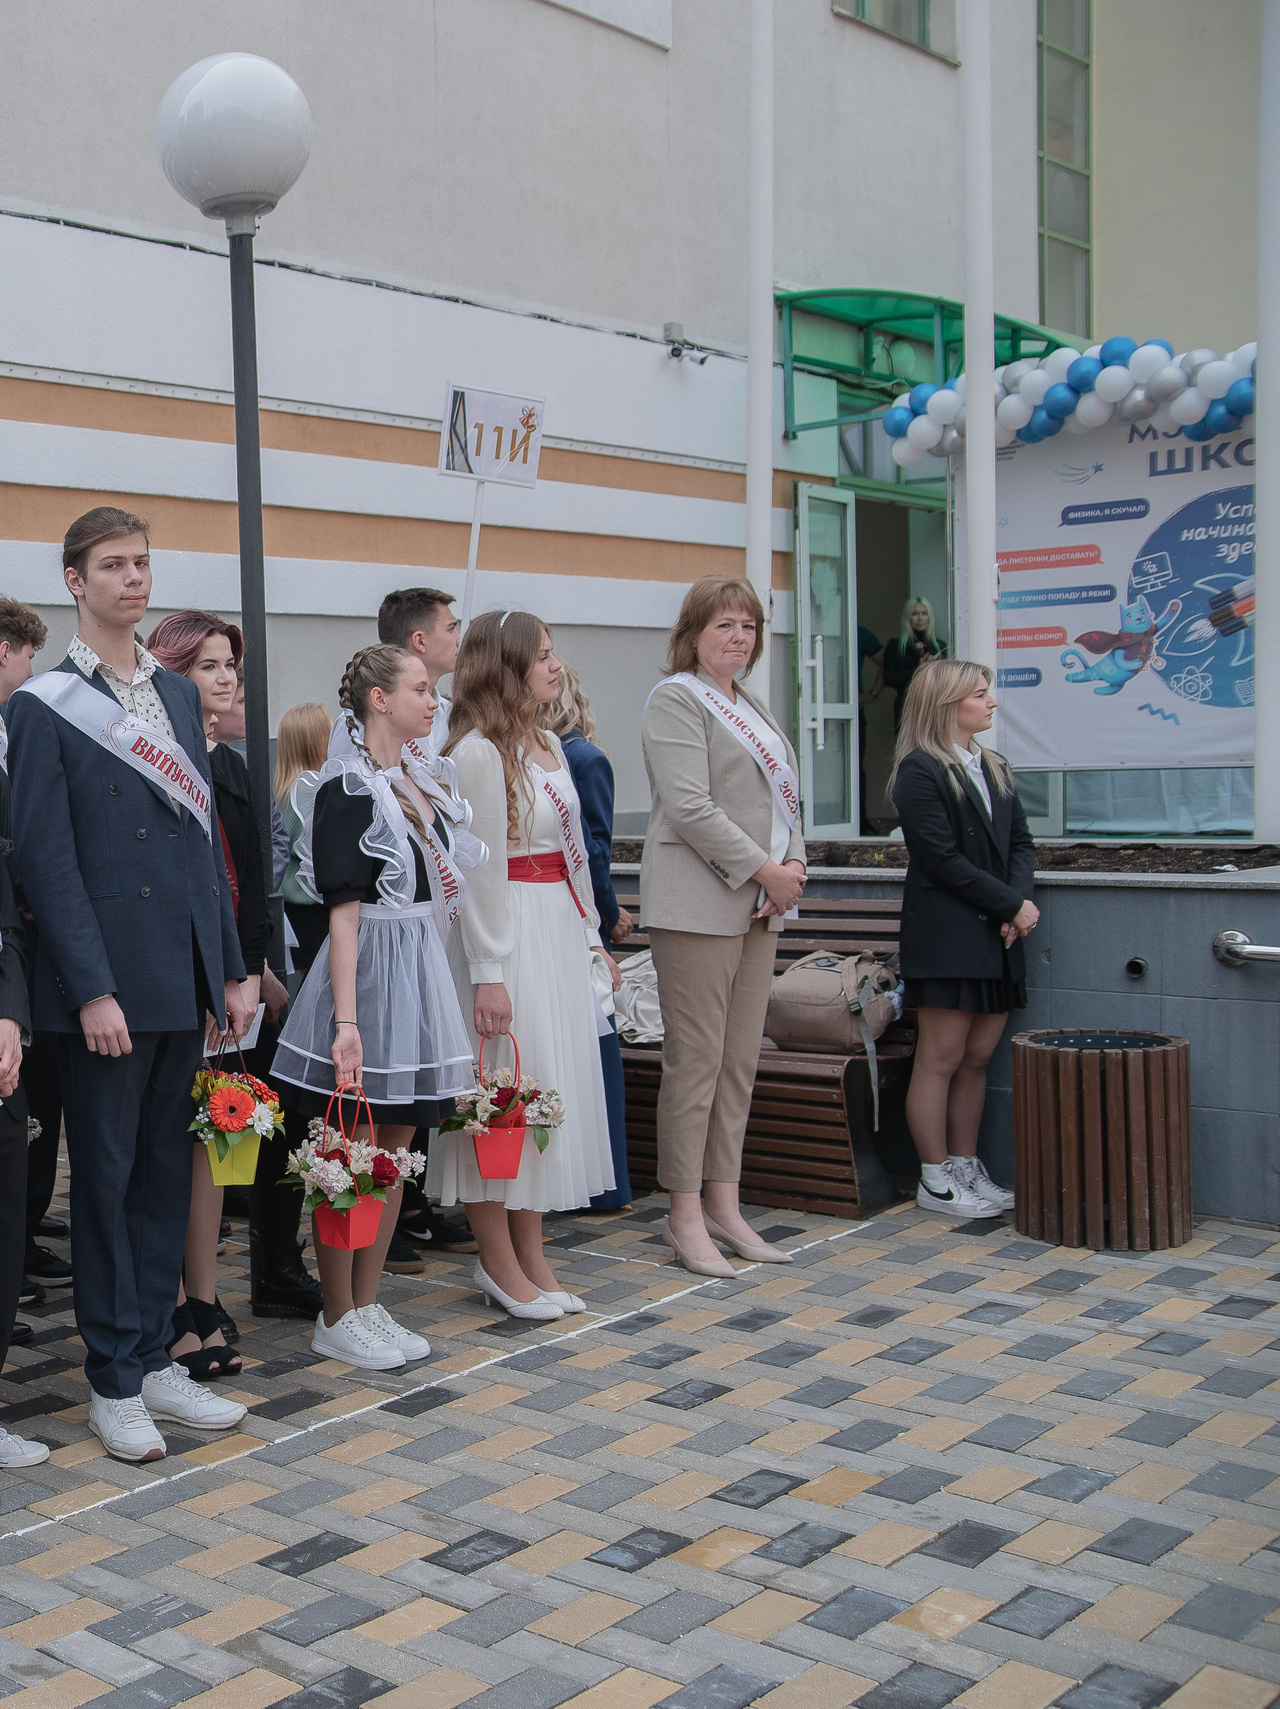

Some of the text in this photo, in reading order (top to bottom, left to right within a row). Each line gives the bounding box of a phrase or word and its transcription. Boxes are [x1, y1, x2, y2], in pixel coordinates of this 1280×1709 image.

[1068, 509, 1103, 519] ФИЗИКА,
[1111, 504, 1146, 514] СКУЧАЛ!
[1215, 502, 1256, 520] Усп
[1009, 555, 1048, 565] ЛИСТОЧКИ
[1049, 550, 1099, 562] ДОСТАВАТЬ?
[1215, 541, 1256, 564] зде
[1021, 593, 1047, 602] ТОЧНО
[1048, 591, 1079, 600] ПОПАДУ
[1081, 590, 1088, 598] В
[1089, 589, 1111, 597] РЕКИ!
[1034, 632, 1063, 640] СКОРО?
[1007, 672, 1037, 682] ДОШЁЛ!
[705, 691, 799, 814] ВЫПУСКНИК 2023
